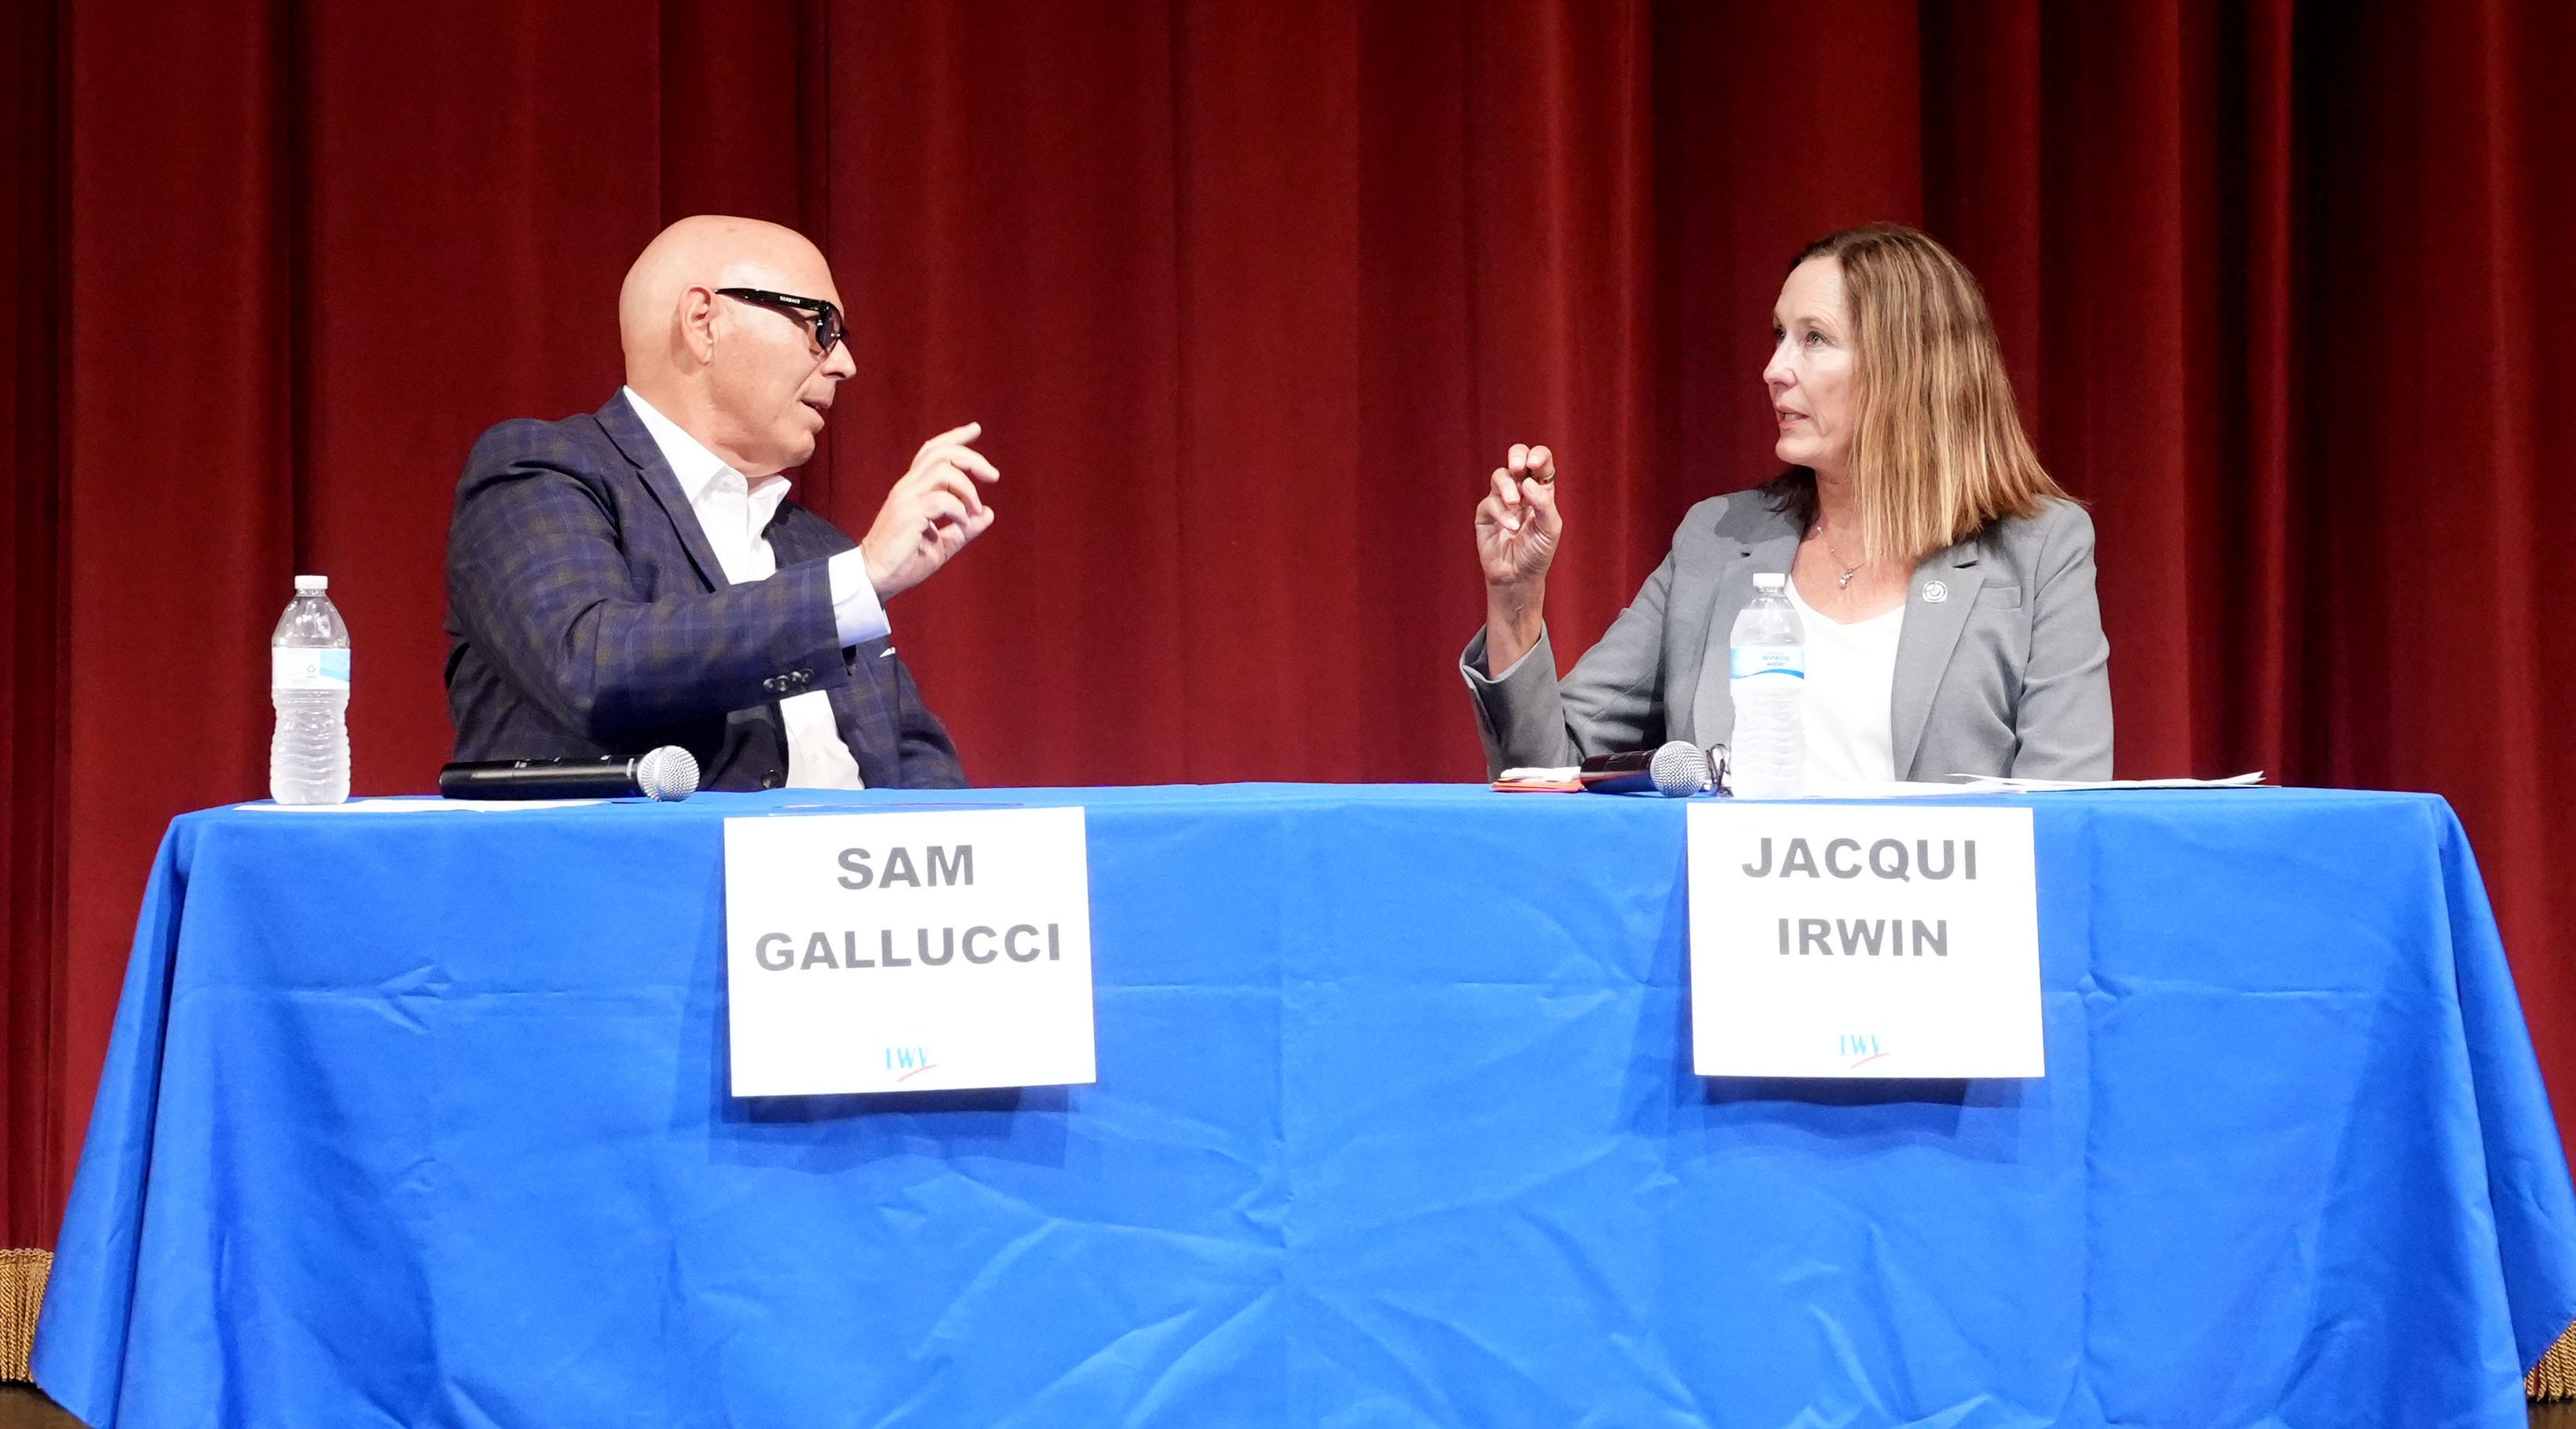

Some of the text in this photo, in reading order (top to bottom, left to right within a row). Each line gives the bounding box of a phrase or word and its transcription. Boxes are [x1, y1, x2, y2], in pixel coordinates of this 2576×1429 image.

[836, 845, 974, 890] SAM
[1741, 837, 1977, 883] JACQUI
[755, 922, 1060, 971] GALLUCCI
[1778, 918, 1948, 956] IRWIN
